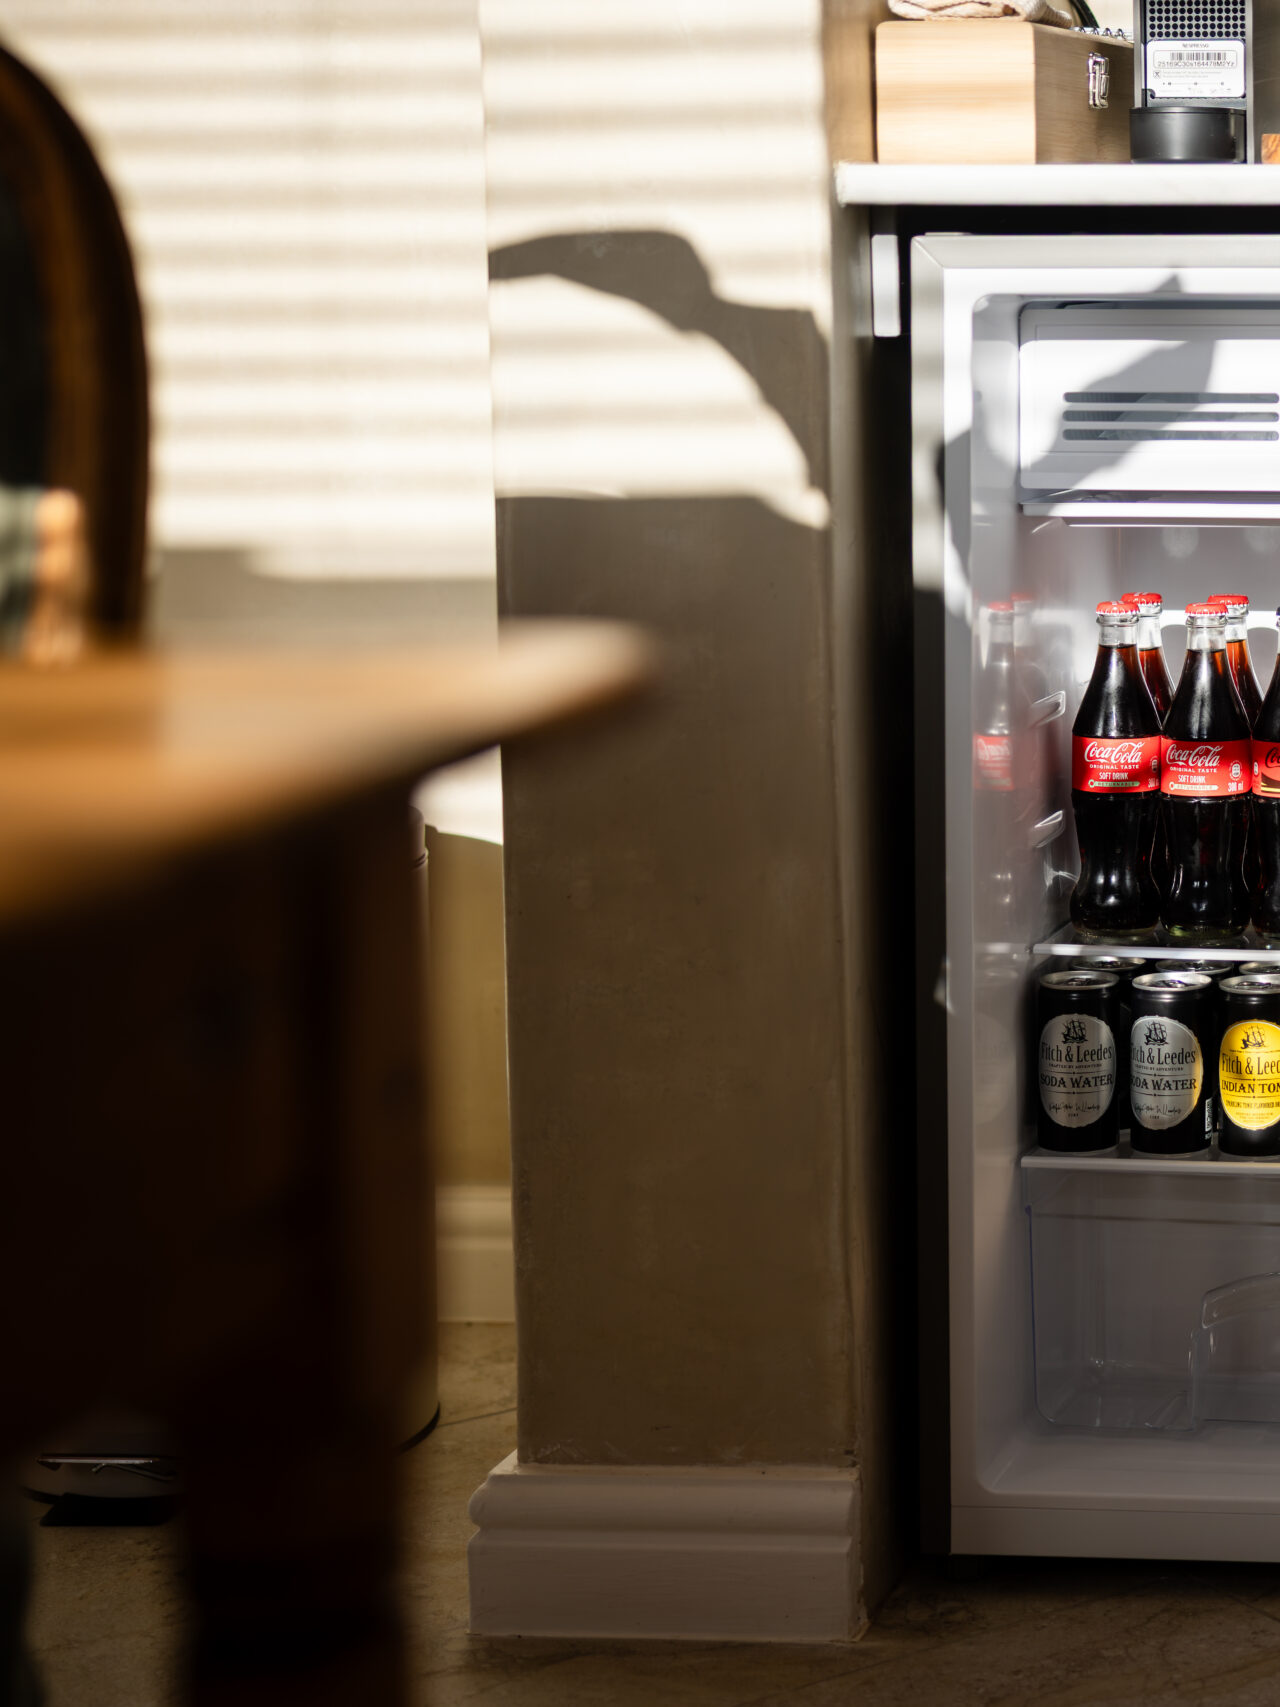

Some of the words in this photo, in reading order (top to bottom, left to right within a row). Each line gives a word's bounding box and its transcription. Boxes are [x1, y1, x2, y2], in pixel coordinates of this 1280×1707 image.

[1084, 741, 1146, 764] Coca-Cola
[1166, 743, 1224, 767] Coca-Cola
[1099, 771, 1112, 780] SOFT
[1113, 771, 1129, 780] DRINK
[1178, 774, 1189, 783] SOFT
[1190, 775, 1206, 783] DRINK
[1041, 1042, 1062, 1063] Fitch
[1064, 1045, 1074, 1062] &
[1077, 1044, 1112, 1062] Leedes
[1147, 1047, 1155, 1064] &
[1158, 1048, 1196, 1065] Leedes
[1222, 1053, 1242, 1075] Fitch
[1245, 1057, 1253, 1075] &
[1040, 1073, 1066, 1088] SODA
[1070, 1073, 1113, 1088] WATER
[1151, 1077, 1197, 1091] WATER
[1221, 1080, 1255, 1094] INDIAN
